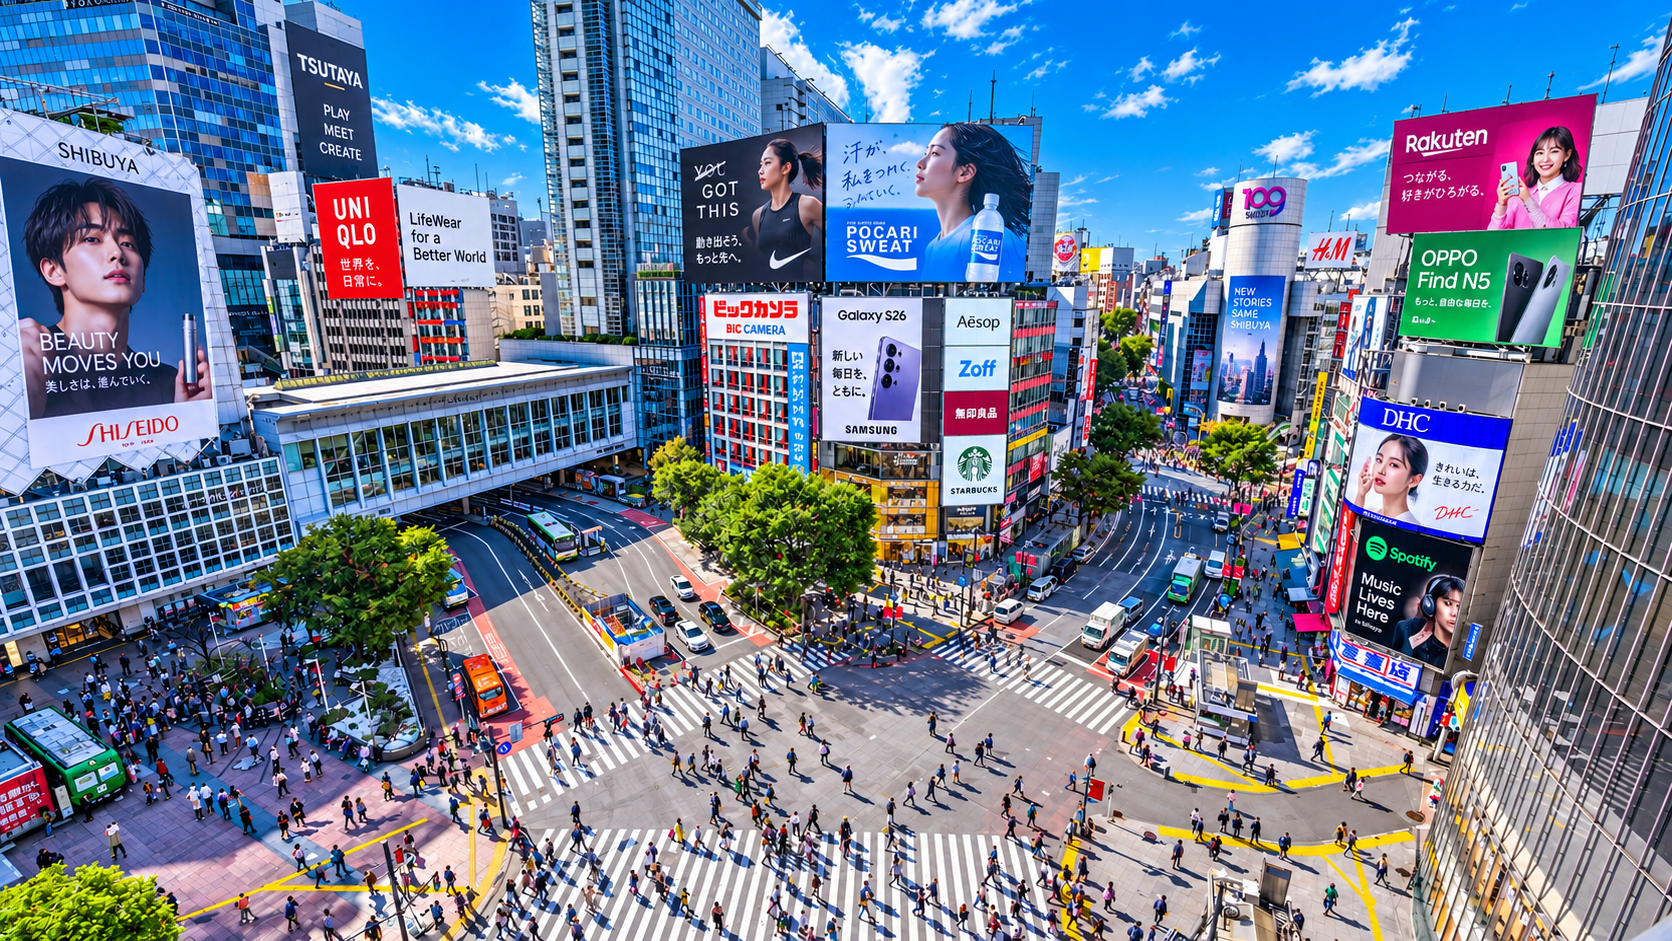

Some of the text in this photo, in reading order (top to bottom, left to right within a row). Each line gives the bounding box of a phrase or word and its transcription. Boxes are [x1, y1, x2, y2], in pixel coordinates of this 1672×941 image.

[297, 53, 363, 89] TSUTAYA
[323, 103, 350, 121] PLAY
[324, 123, 354, 140] MEET
[1405, 129, 1488, 153] Rakuten
[58, 142, 139, 174] SHIBUYA
[319, 142, 362, 161] CREATE
[1403, 169, 1451, 183] つながる、
[702, 181, 738, 199] GOT
[333, 196, 370, 220] UNI
[696, 202, 739, 219] THIS
[1242, 186, 1287, 218] 109
[409, 212, 461, 229] LifeWear
[337, 223, 376, 249] QLO
[411, 229, 441, 244] for a
[847, 226, 917, 239] POCARI
[413, 247, 486, 263] Better World
[847, 240, 912, 253] SWEAT
[1312, 237, 1352, 261] H&M
[1421, 249, 1478, 267] OPPO
[1417, 271, 1491, 289] Find N5
[1234, 287, 1256, 296] NEW
[1233, 298, 1272, 307] STORIES
[837, 310, 907, 324] Galaxy S26
[956, 315, 1000, 331] Aësop
[1231, 309, 1258, 319] SAME
[743, 324, 786, 335] CAMERA
[1230, 320, 1271, 330] SHIBUYA
[40, 332, 119, 351] BEAUTY
[43, 351, 160, 374] MOVES YOU
[832, 349, 863, 362] 新しい
[958, 359, 996, 377] Zoff
[955, 407, 998, 419] 無印良品
[1381, 408, 1430, 433] DHC
[77, 415, 179, 447] SHISEIDO
[845, 425, 897, 435] SAMSUNG
[950, 486, 998, 495] STARBUCKS
[1434, 505, 1477, 520] DHC
[1389, 547, 1437, 572] Spotify
[1361, 571, 1402, 596] Music
[1359, 586, 1395, 610] Lives
[1356, 600, 1389, 623] Here
